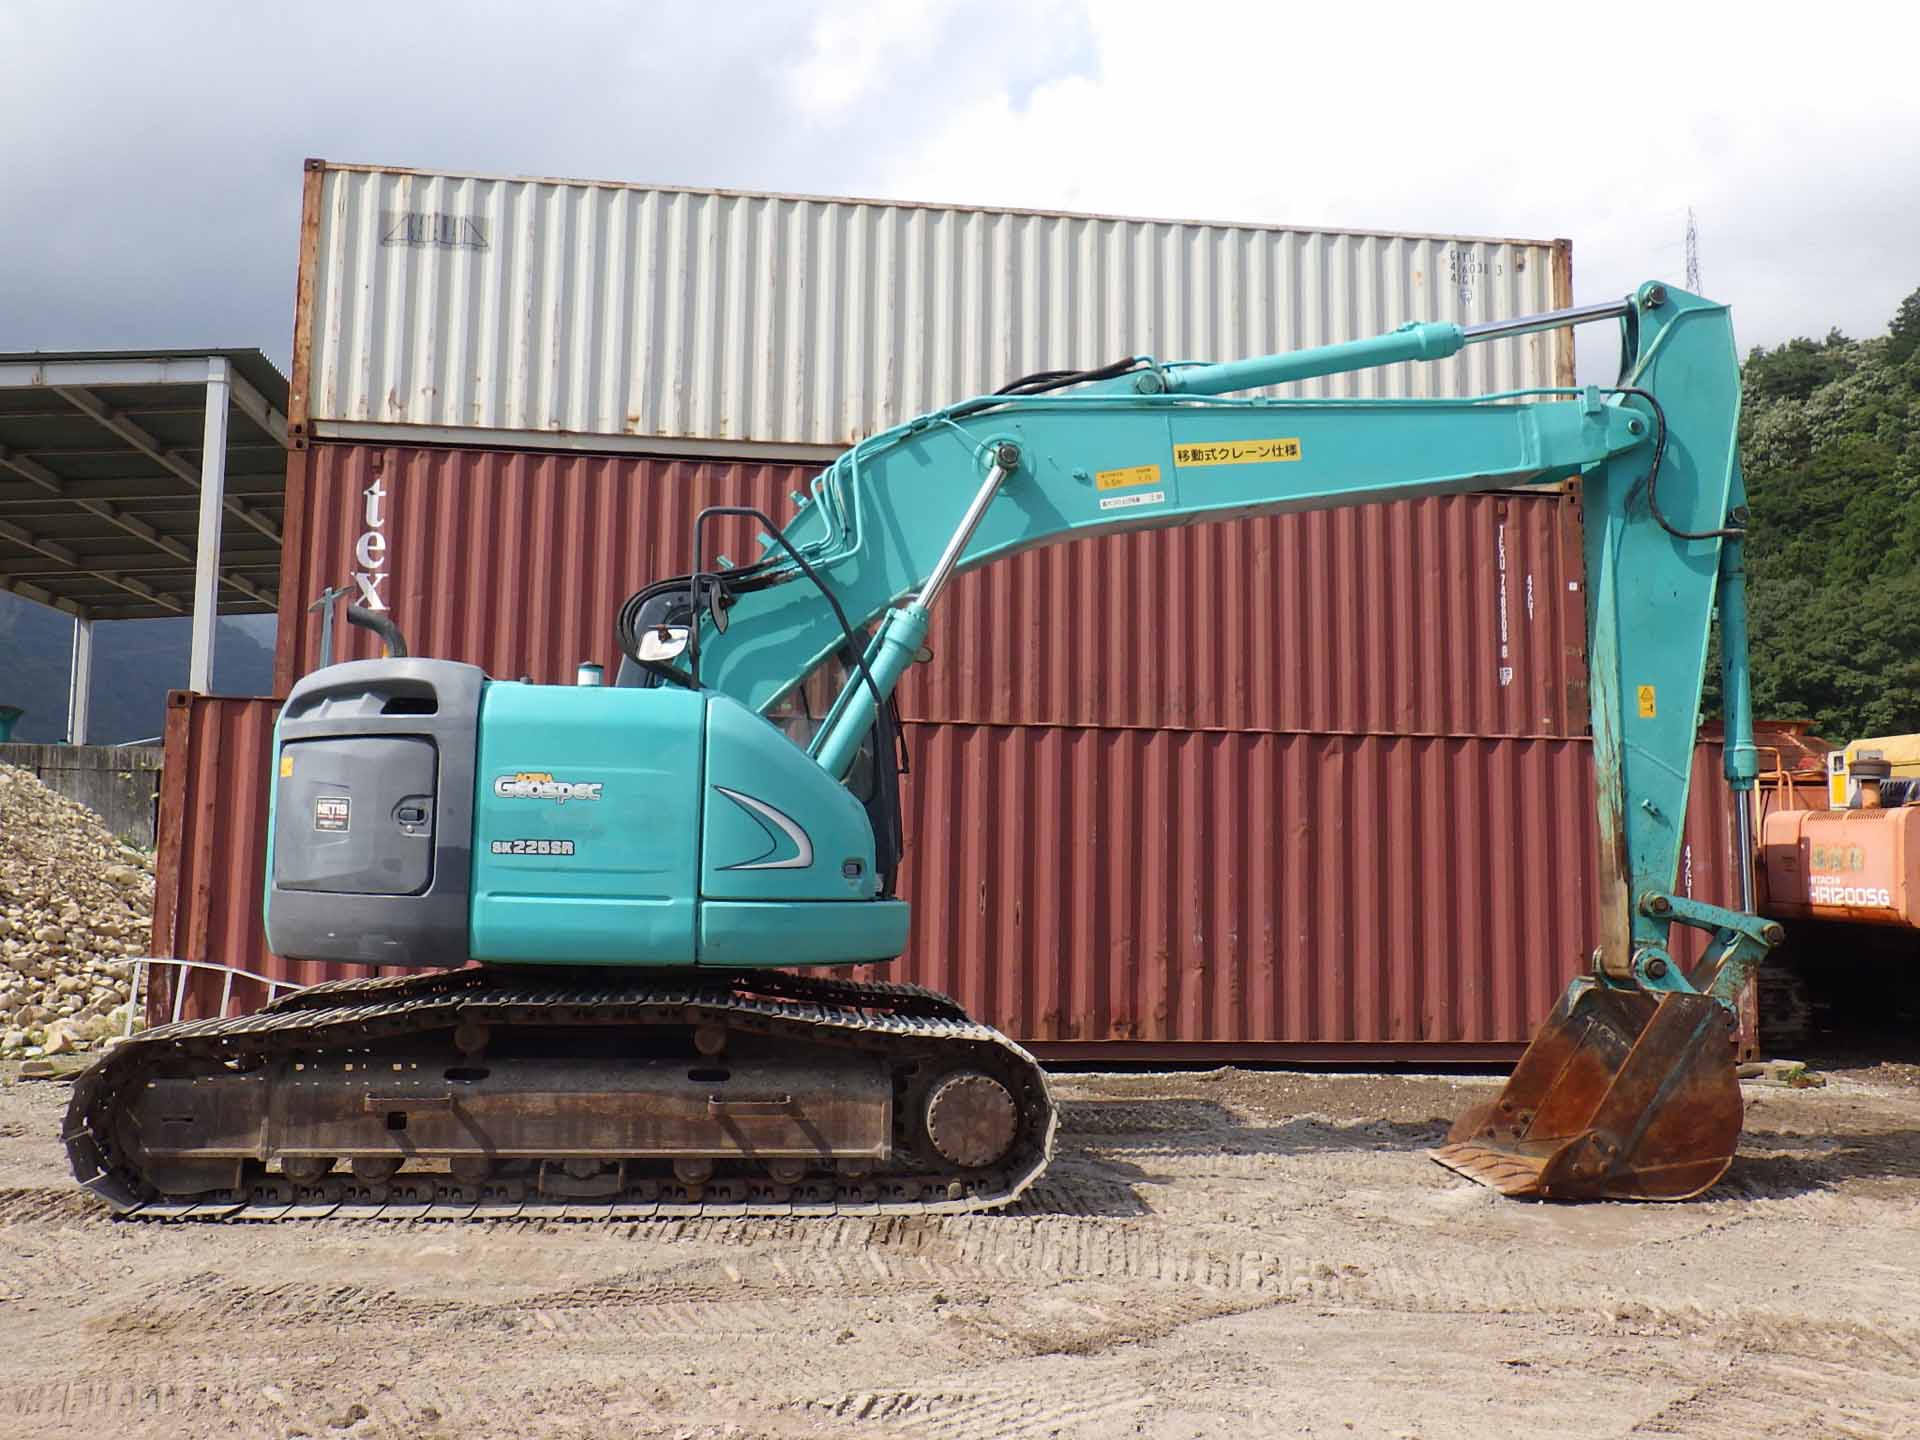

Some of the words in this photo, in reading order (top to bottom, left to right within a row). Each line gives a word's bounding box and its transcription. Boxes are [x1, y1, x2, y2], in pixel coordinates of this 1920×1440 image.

[1176, 443, 1298, 463] 移動式クレーン仕様
[351, 478, 391, 610] tex
